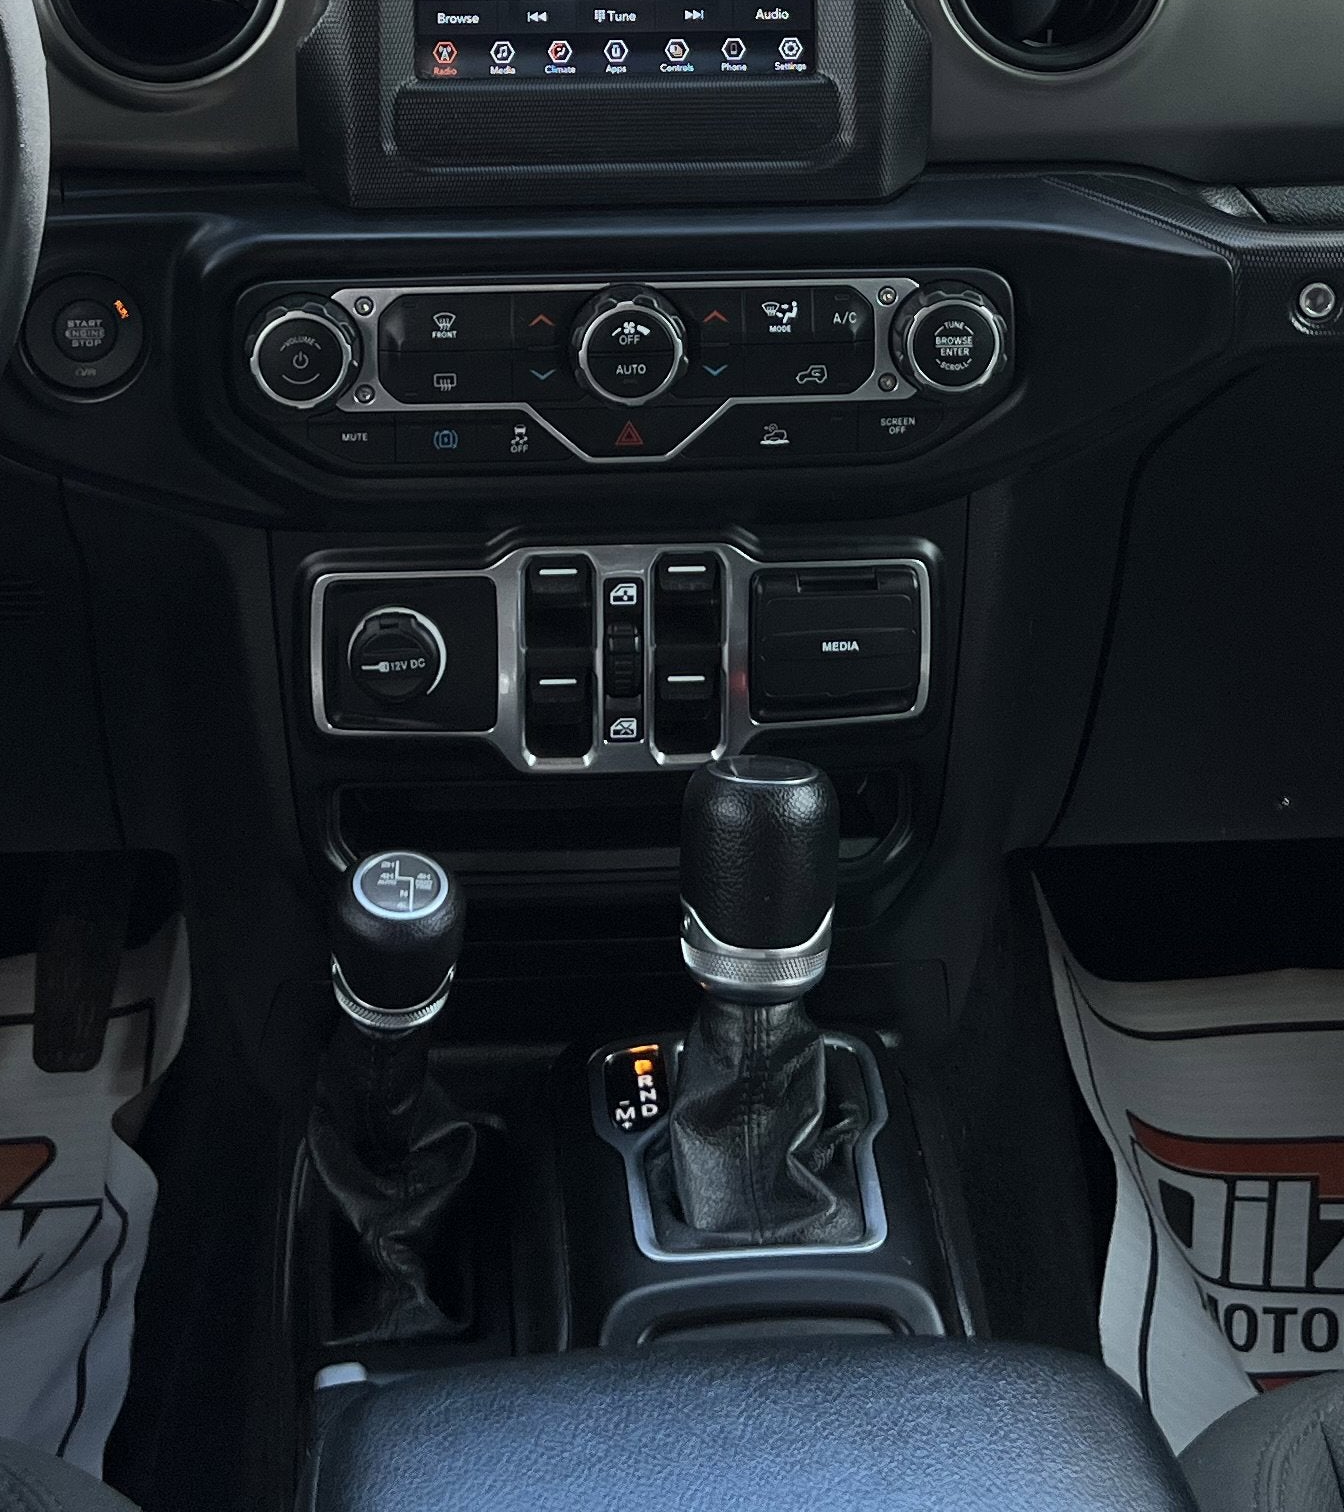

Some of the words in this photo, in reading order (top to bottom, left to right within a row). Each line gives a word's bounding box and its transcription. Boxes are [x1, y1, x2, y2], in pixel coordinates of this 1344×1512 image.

[437, 12, 480, 24] Browse
[606, 10, 637, 22] Tune
[755, 8, 790, 20] Audio
[433, 66, 458, 76] Radio
[490, 65, 516, 75] Media
[544, 64, 577, 75] Climate
[605, 64, 627, 75] Apps
[660, 63, 695, 73] Controls
[721, 62, 748, 72] Phone
[774, 61, 807, 72] Settings
[832, 311, 857, 325] A/C
[67, 319, 103, 328] START
[944, 321, 965, 331] TUNE
[67, 329, 105, 338] ENGINE
[769, 325, 792, 333] MODE
[431, 330, 457, 339] FRONT
[71, 339, 102, 348] STOP
[618, 335, 641, 346] OFF
[935, 337, 973, 345] BROWSE
[940, 348, 970, 357] ENTER
[616, 364, 647, 376] AUTO
[940, 361, 969, 371] SCROLL
[880, 417, 916, 427] SCREEN
[888, 426, 907, 435] OFF
[342, 433, 368, 442] MUTE
[510, 444, 529, 454] OFF
[822, 641, 859, 654] MEDIA
[389, 660, 409, 672] 12V
[410, 658, 427, 670] DC
[638, 1074, 654, 1088] R
[639, 1088, 657, 1102] N
[615, 1106, 636, 1121] M
[641, 1103, 659, 1118] D
